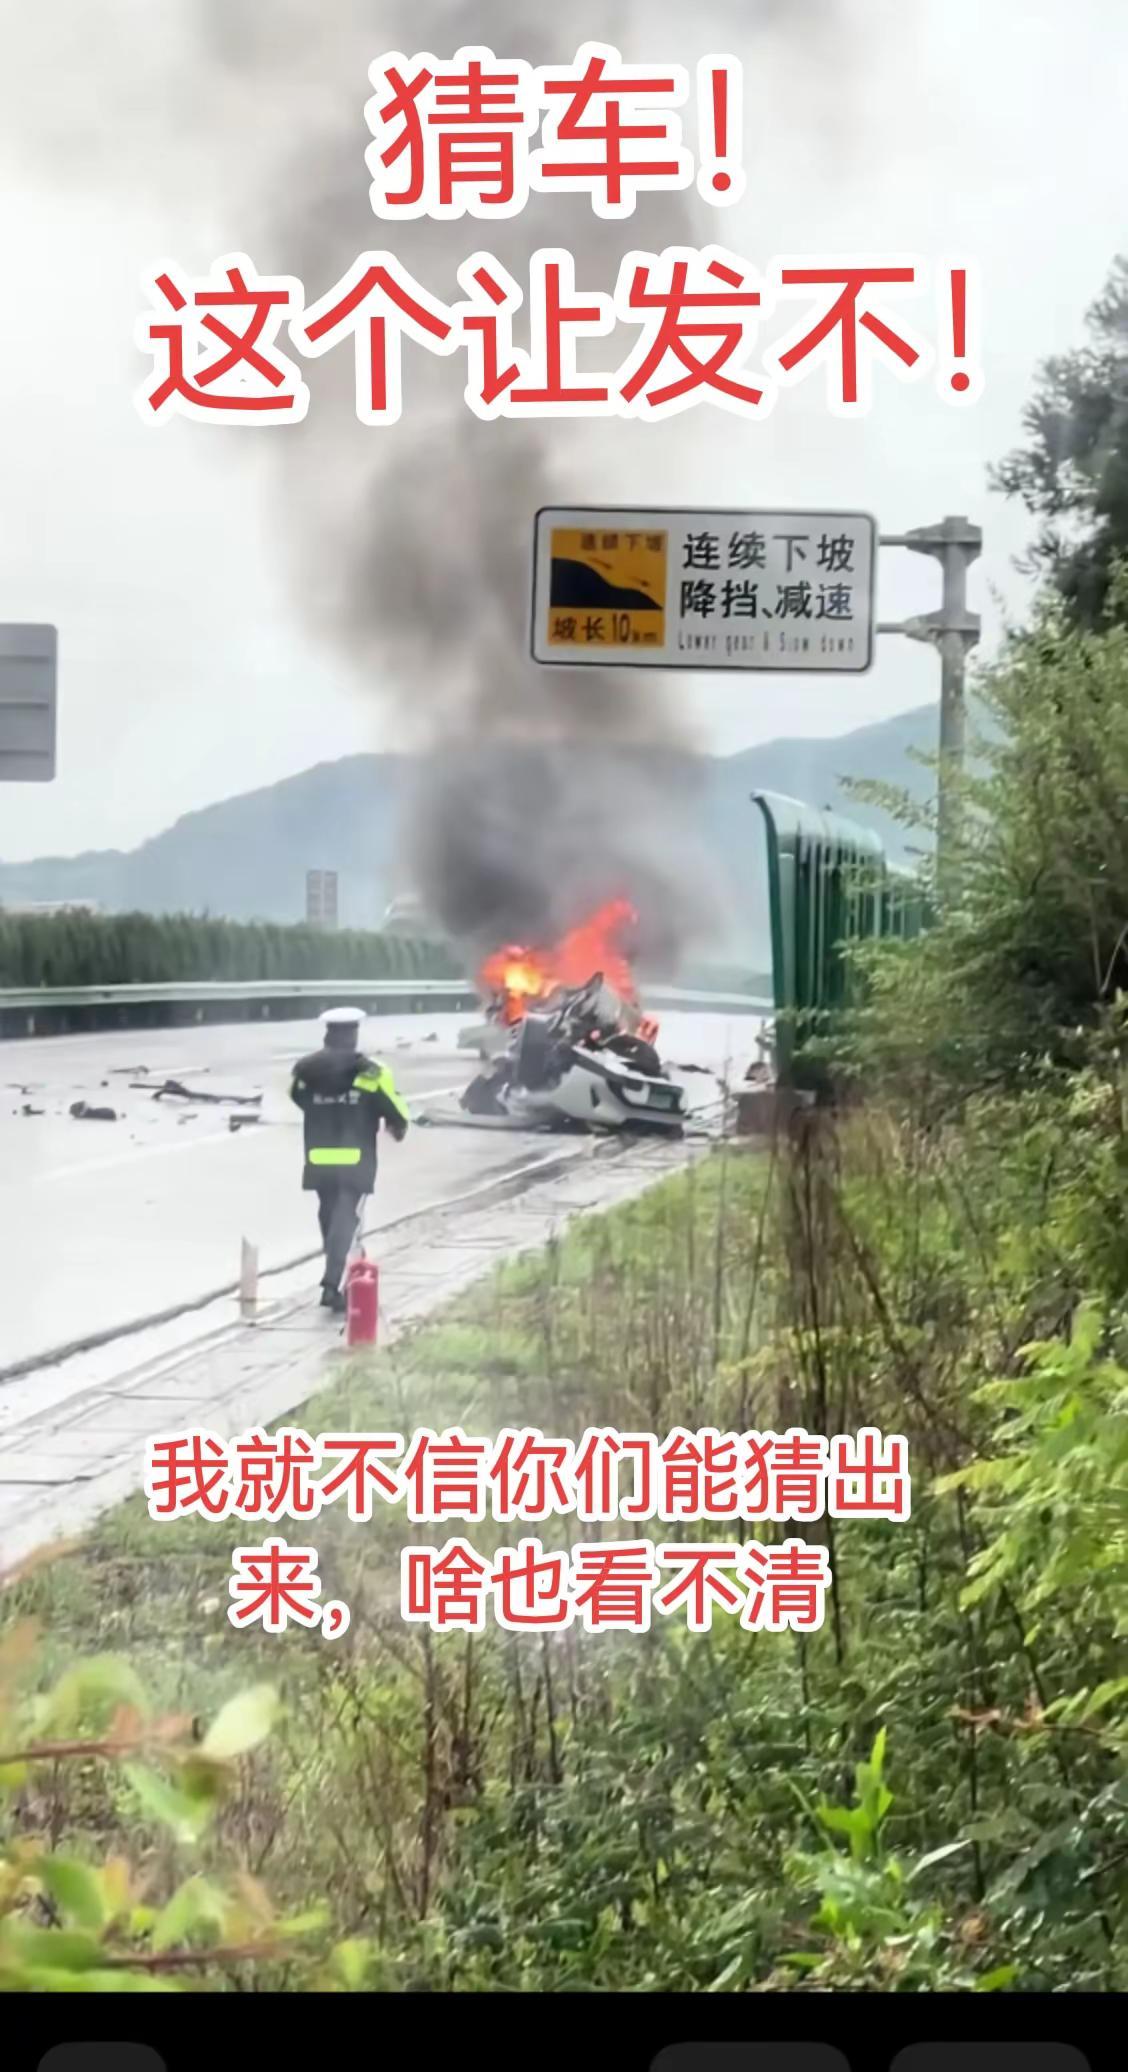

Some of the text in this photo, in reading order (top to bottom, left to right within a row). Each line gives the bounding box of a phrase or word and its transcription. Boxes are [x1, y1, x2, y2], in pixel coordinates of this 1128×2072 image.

[682, 531, 855, 572] 连续下坡
[679, 579, 854, 620] 降挡、减速
